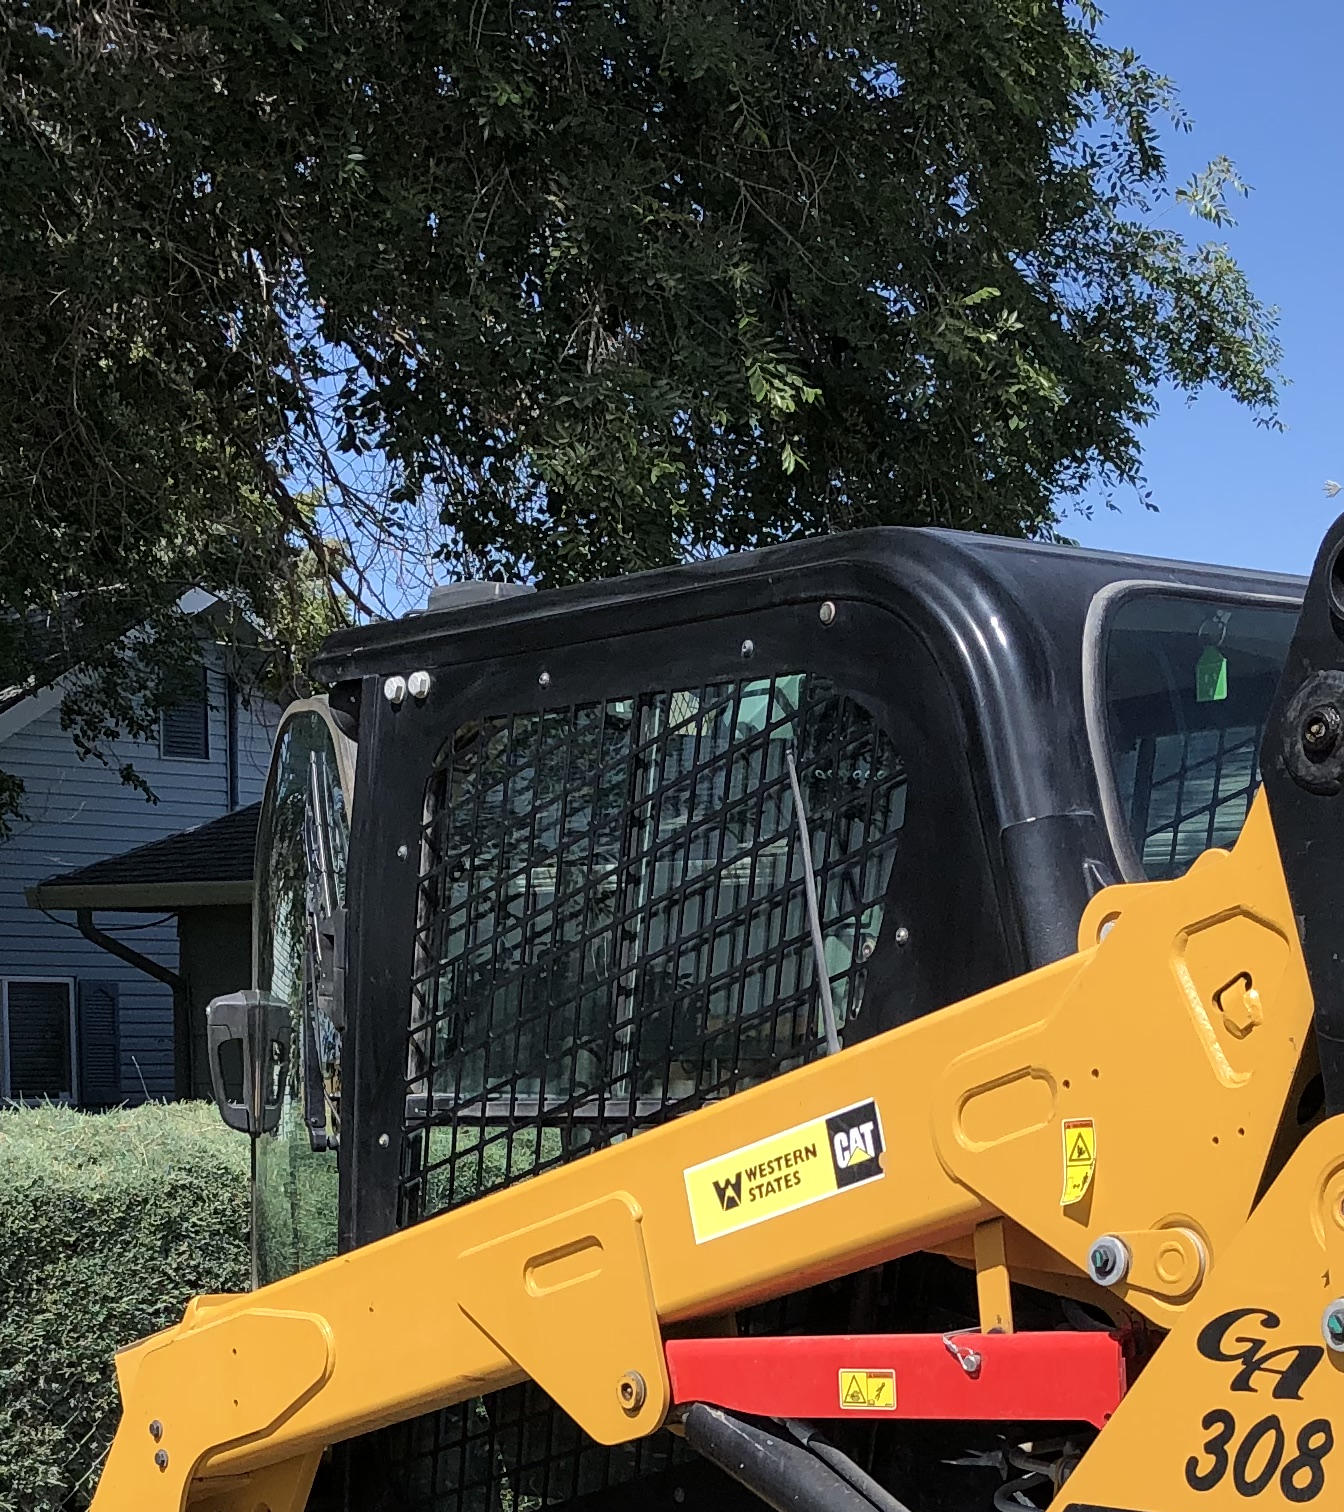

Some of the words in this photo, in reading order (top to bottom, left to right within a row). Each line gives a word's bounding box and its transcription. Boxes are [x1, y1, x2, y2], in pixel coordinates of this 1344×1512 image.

[745, 1142, 819, 1183] WESTERN
[832, 1120, 876, 1170] CAT
[748, 1170, 802, 1203] STATES
[1196, 1307, 1325, 1401] GA
[1184, 1408, 1335, 1503] 308
